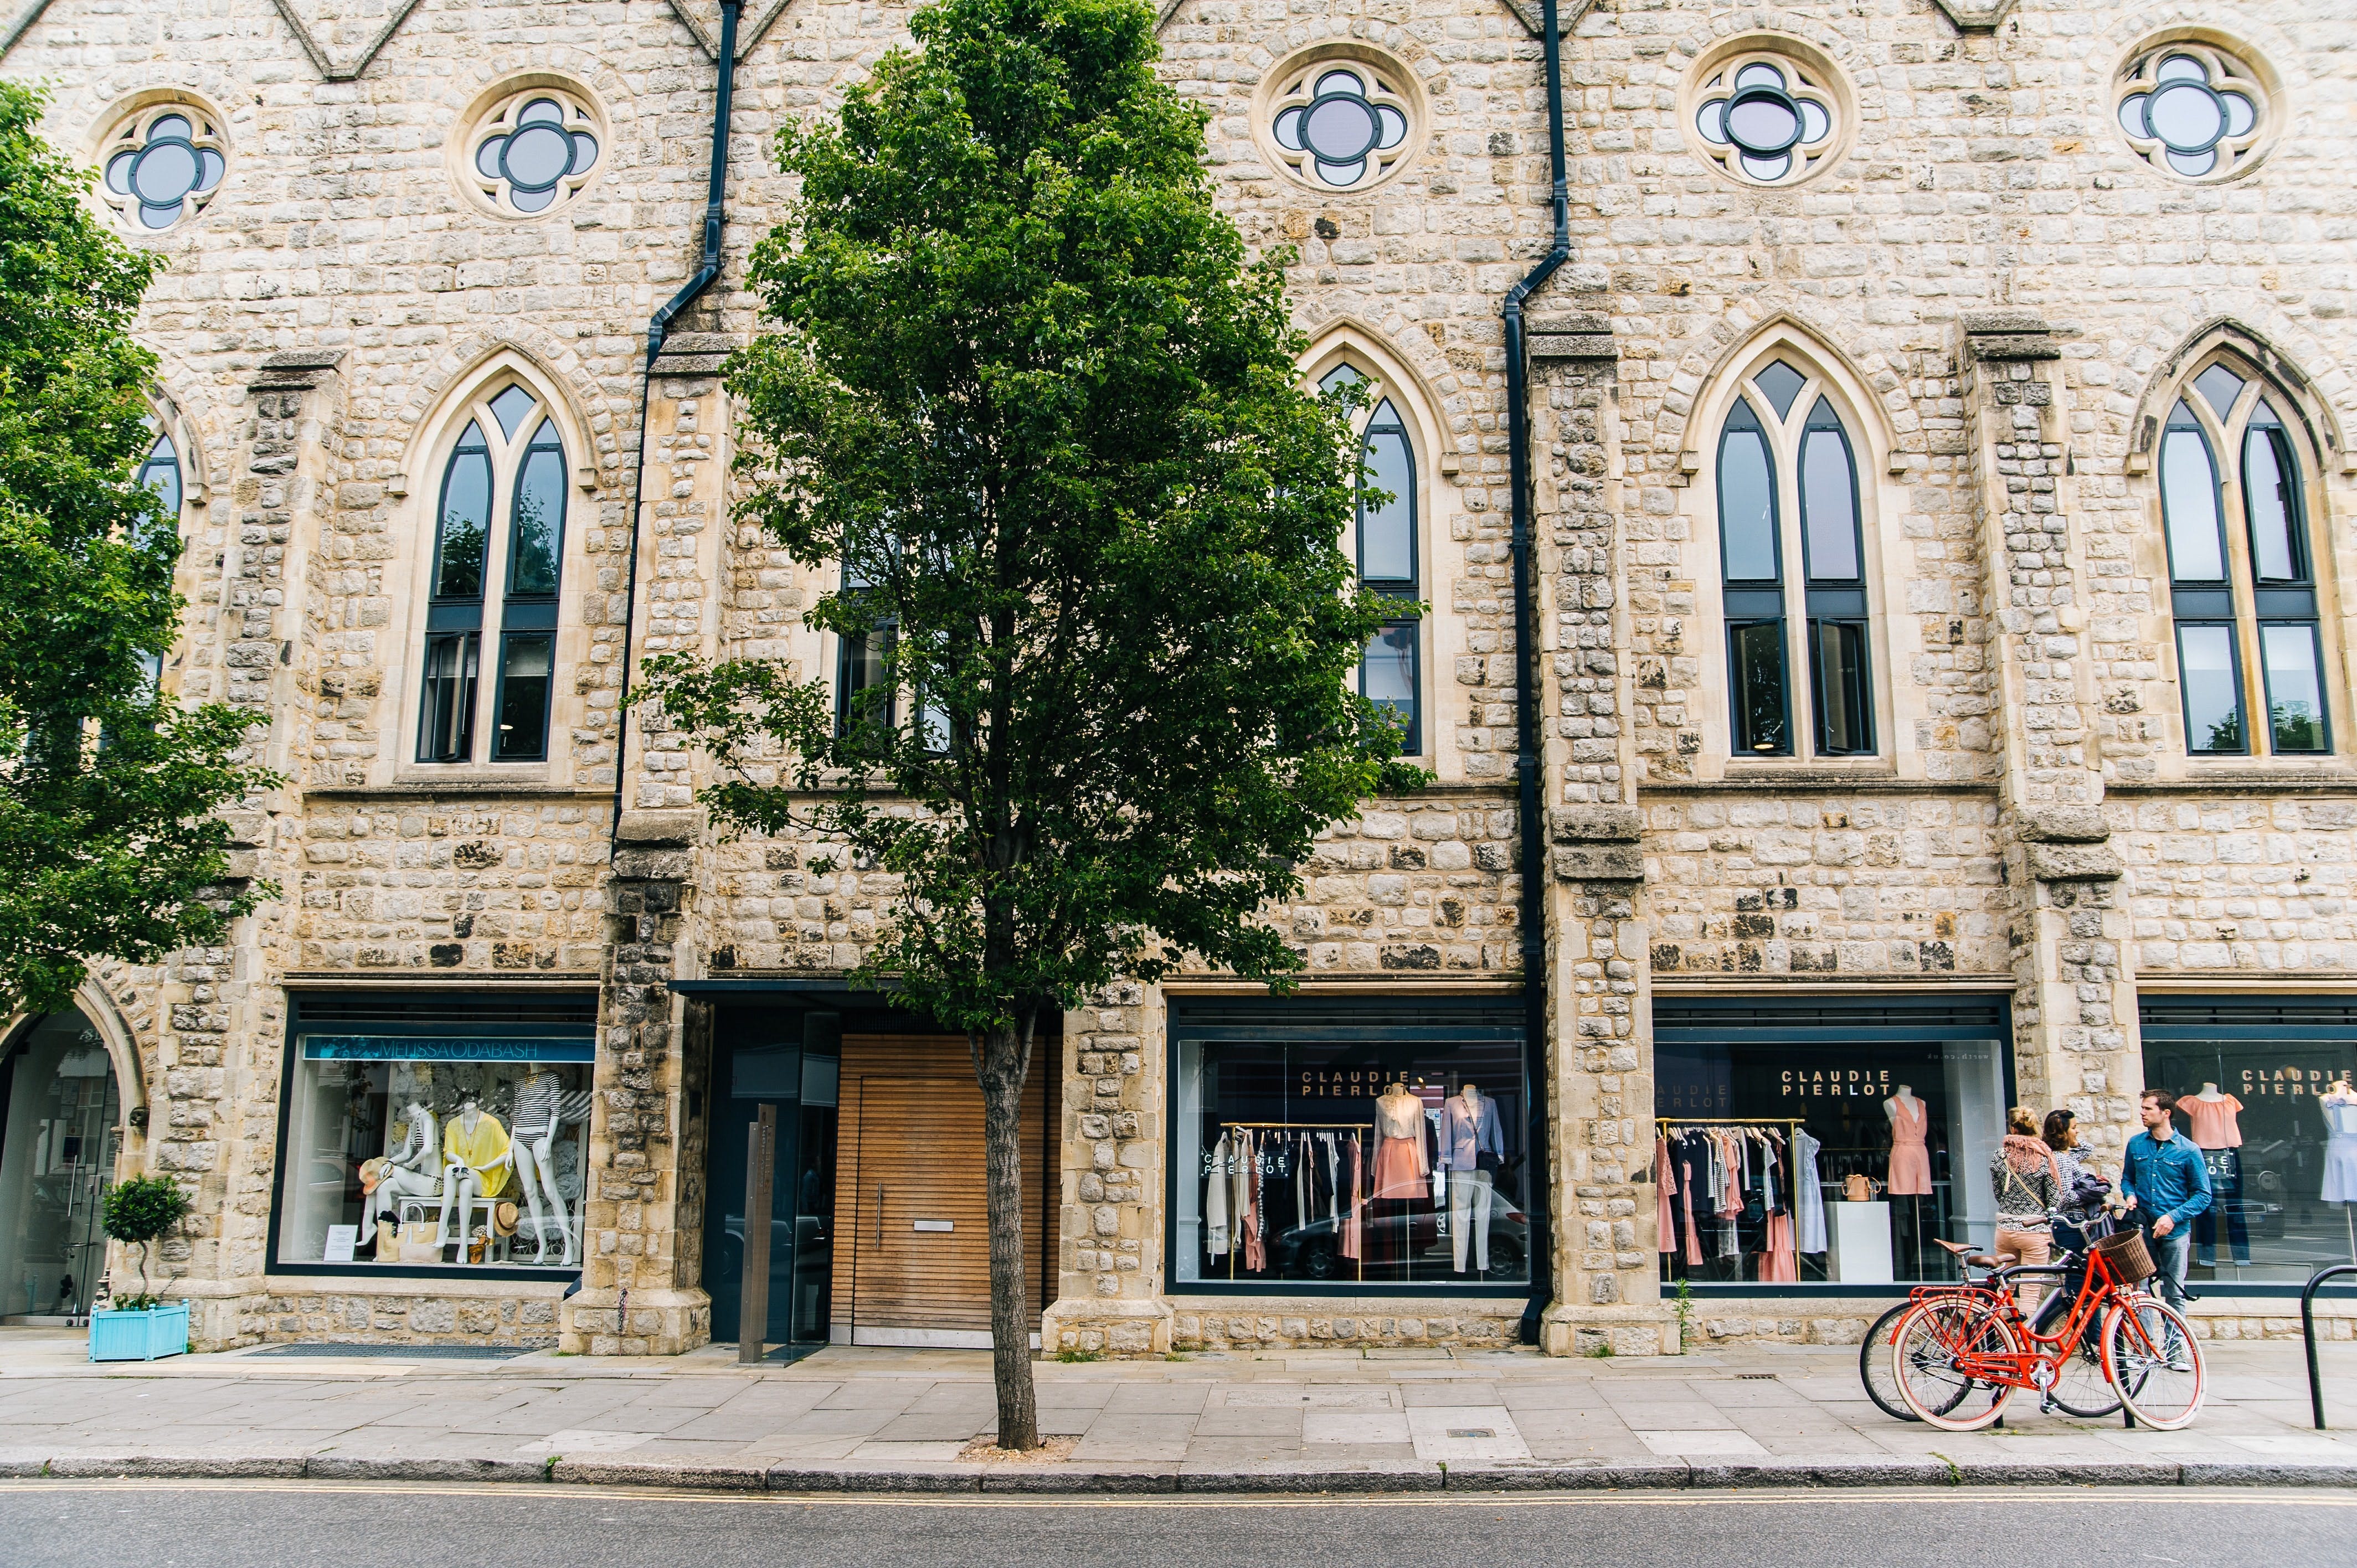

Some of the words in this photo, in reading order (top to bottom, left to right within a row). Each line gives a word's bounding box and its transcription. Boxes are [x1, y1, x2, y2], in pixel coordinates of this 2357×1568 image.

[380, 1040, 449, 1058] MELISSA
[451, 1040, 537, 1058] ODABASH
[1302, 1071, 1408, 1082] CLAUDIE
[1782, 1070, 1889, 1082] CLAUDIE
[2242, 1070, 2353, 1081] CLAUDIE
[1303, 1085, 1408, 1096] PIERLOT
[1656, 1085, 1727, 1095] AUDIE
[1782, 1084, 1889, 1096] PIERLOT
[2243, 1084, 2353, 1096] PIERLOT
[1656, 1097, 1727, 1107] ERLOT
[1205, 1154, 1285, 1165] CLAUDIE
[1205, 1165, 1286, 1174] PIERLOT
